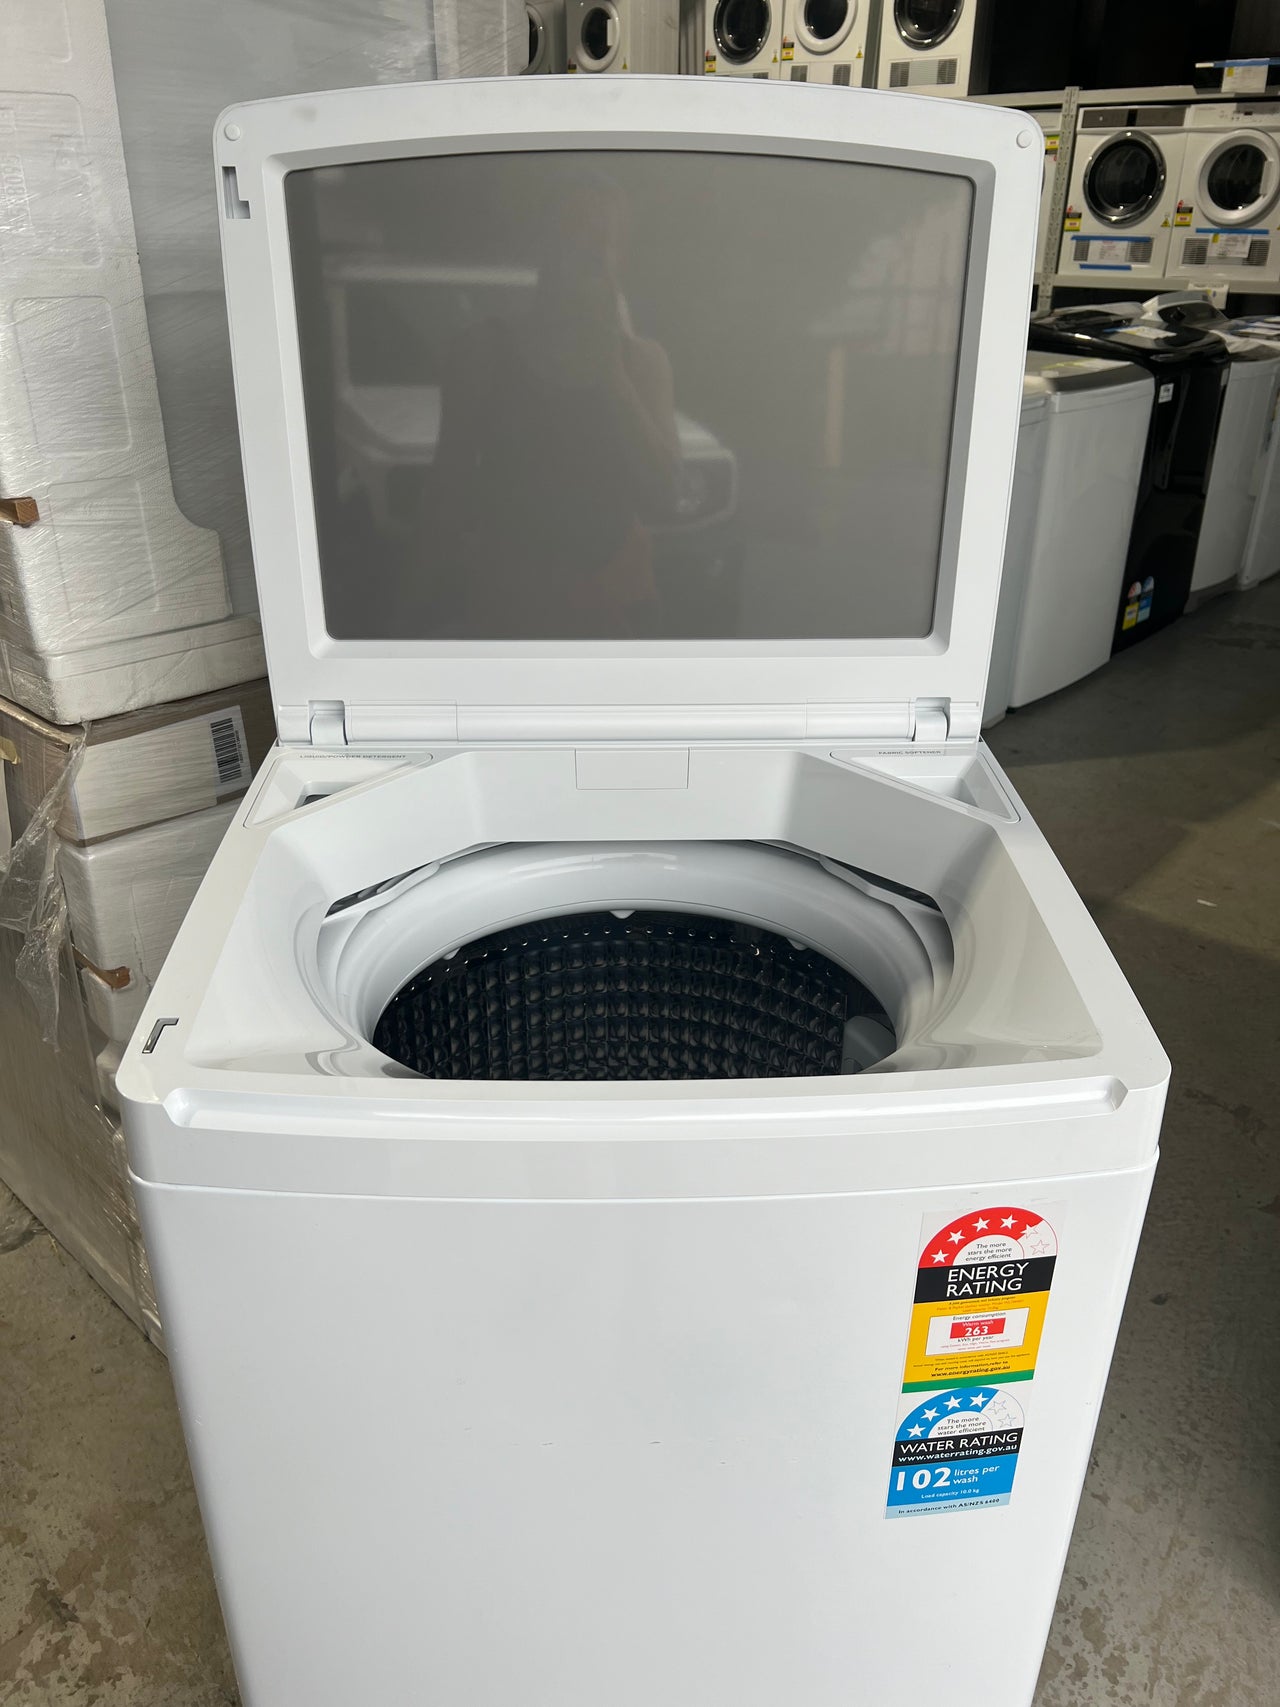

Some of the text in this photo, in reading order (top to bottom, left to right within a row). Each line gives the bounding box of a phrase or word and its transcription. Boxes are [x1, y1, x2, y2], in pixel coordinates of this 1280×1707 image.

[948, 1262, 1029, 1282] ENERGY
[946, 1278, 1023, 1297] RATING
[964, 1325, 989, 1336] 263
[931, 1365, 1011, 1377] www.energyrating.gov.au
[900, 1432, 1018, 1454] WATER RATING
[898, 1444, 1018, 1462] www.waterrating.gov.au
[954, 1465, 1000, 1477] litres per
[896, 1467, 951, 1491] 102
[953, 1475, 978, 1485] wash
[906, 1505, 942, 1513] accordance
